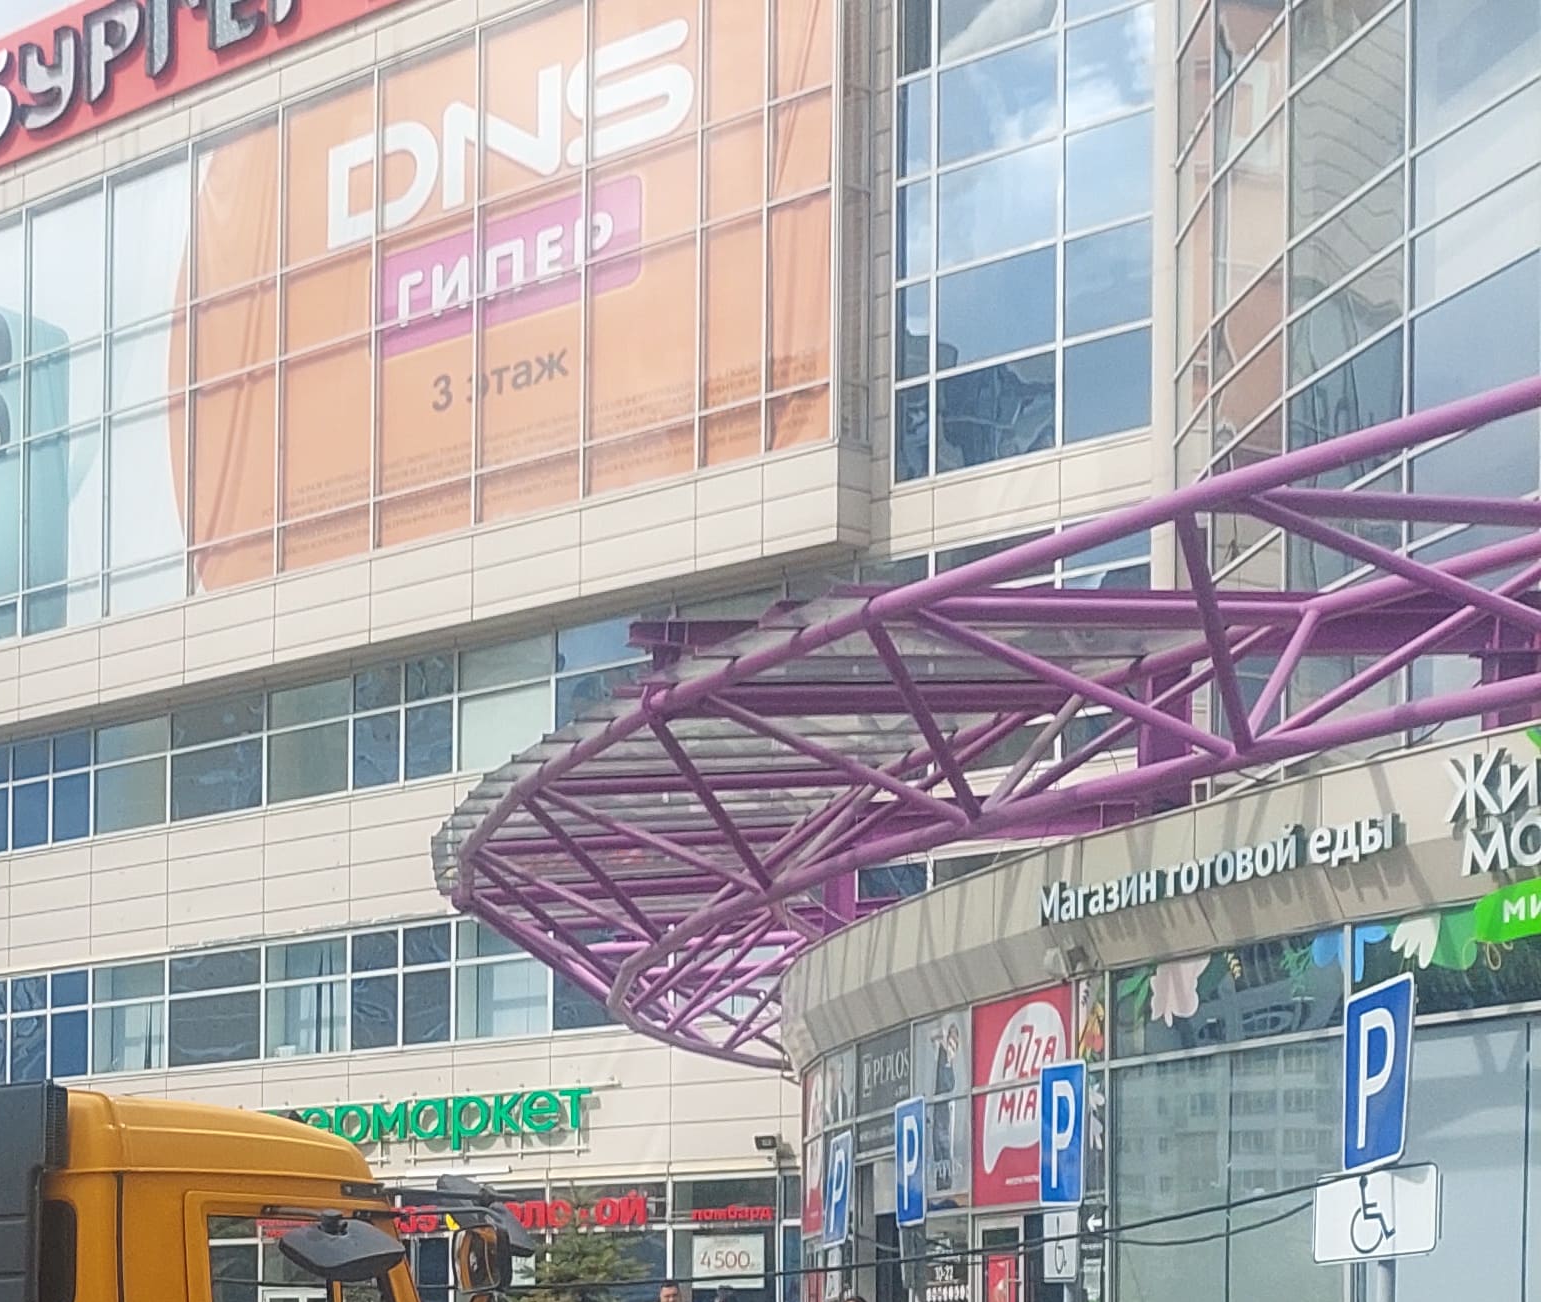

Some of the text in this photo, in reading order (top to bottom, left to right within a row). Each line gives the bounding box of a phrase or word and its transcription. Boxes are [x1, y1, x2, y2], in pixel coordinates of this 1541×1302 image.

[326, 18, 694, 249] DNS
[396, 212, 615, 329] ГИПЕР
[432, 348, 568, 411] 3 этаж
[1038, 815, 1396, 926] Магазин готовой еды
[1002, 1025, 1057, 1078] PIZZA
[1356, 1007, 1395, 1150] P
[269, 1088, 592, 1150] ермаркет
[998, 1088, 1037, 1125] MIA
[1051, 1080, 1075, 1188] P
[903, 1115, 918, 1212] P
